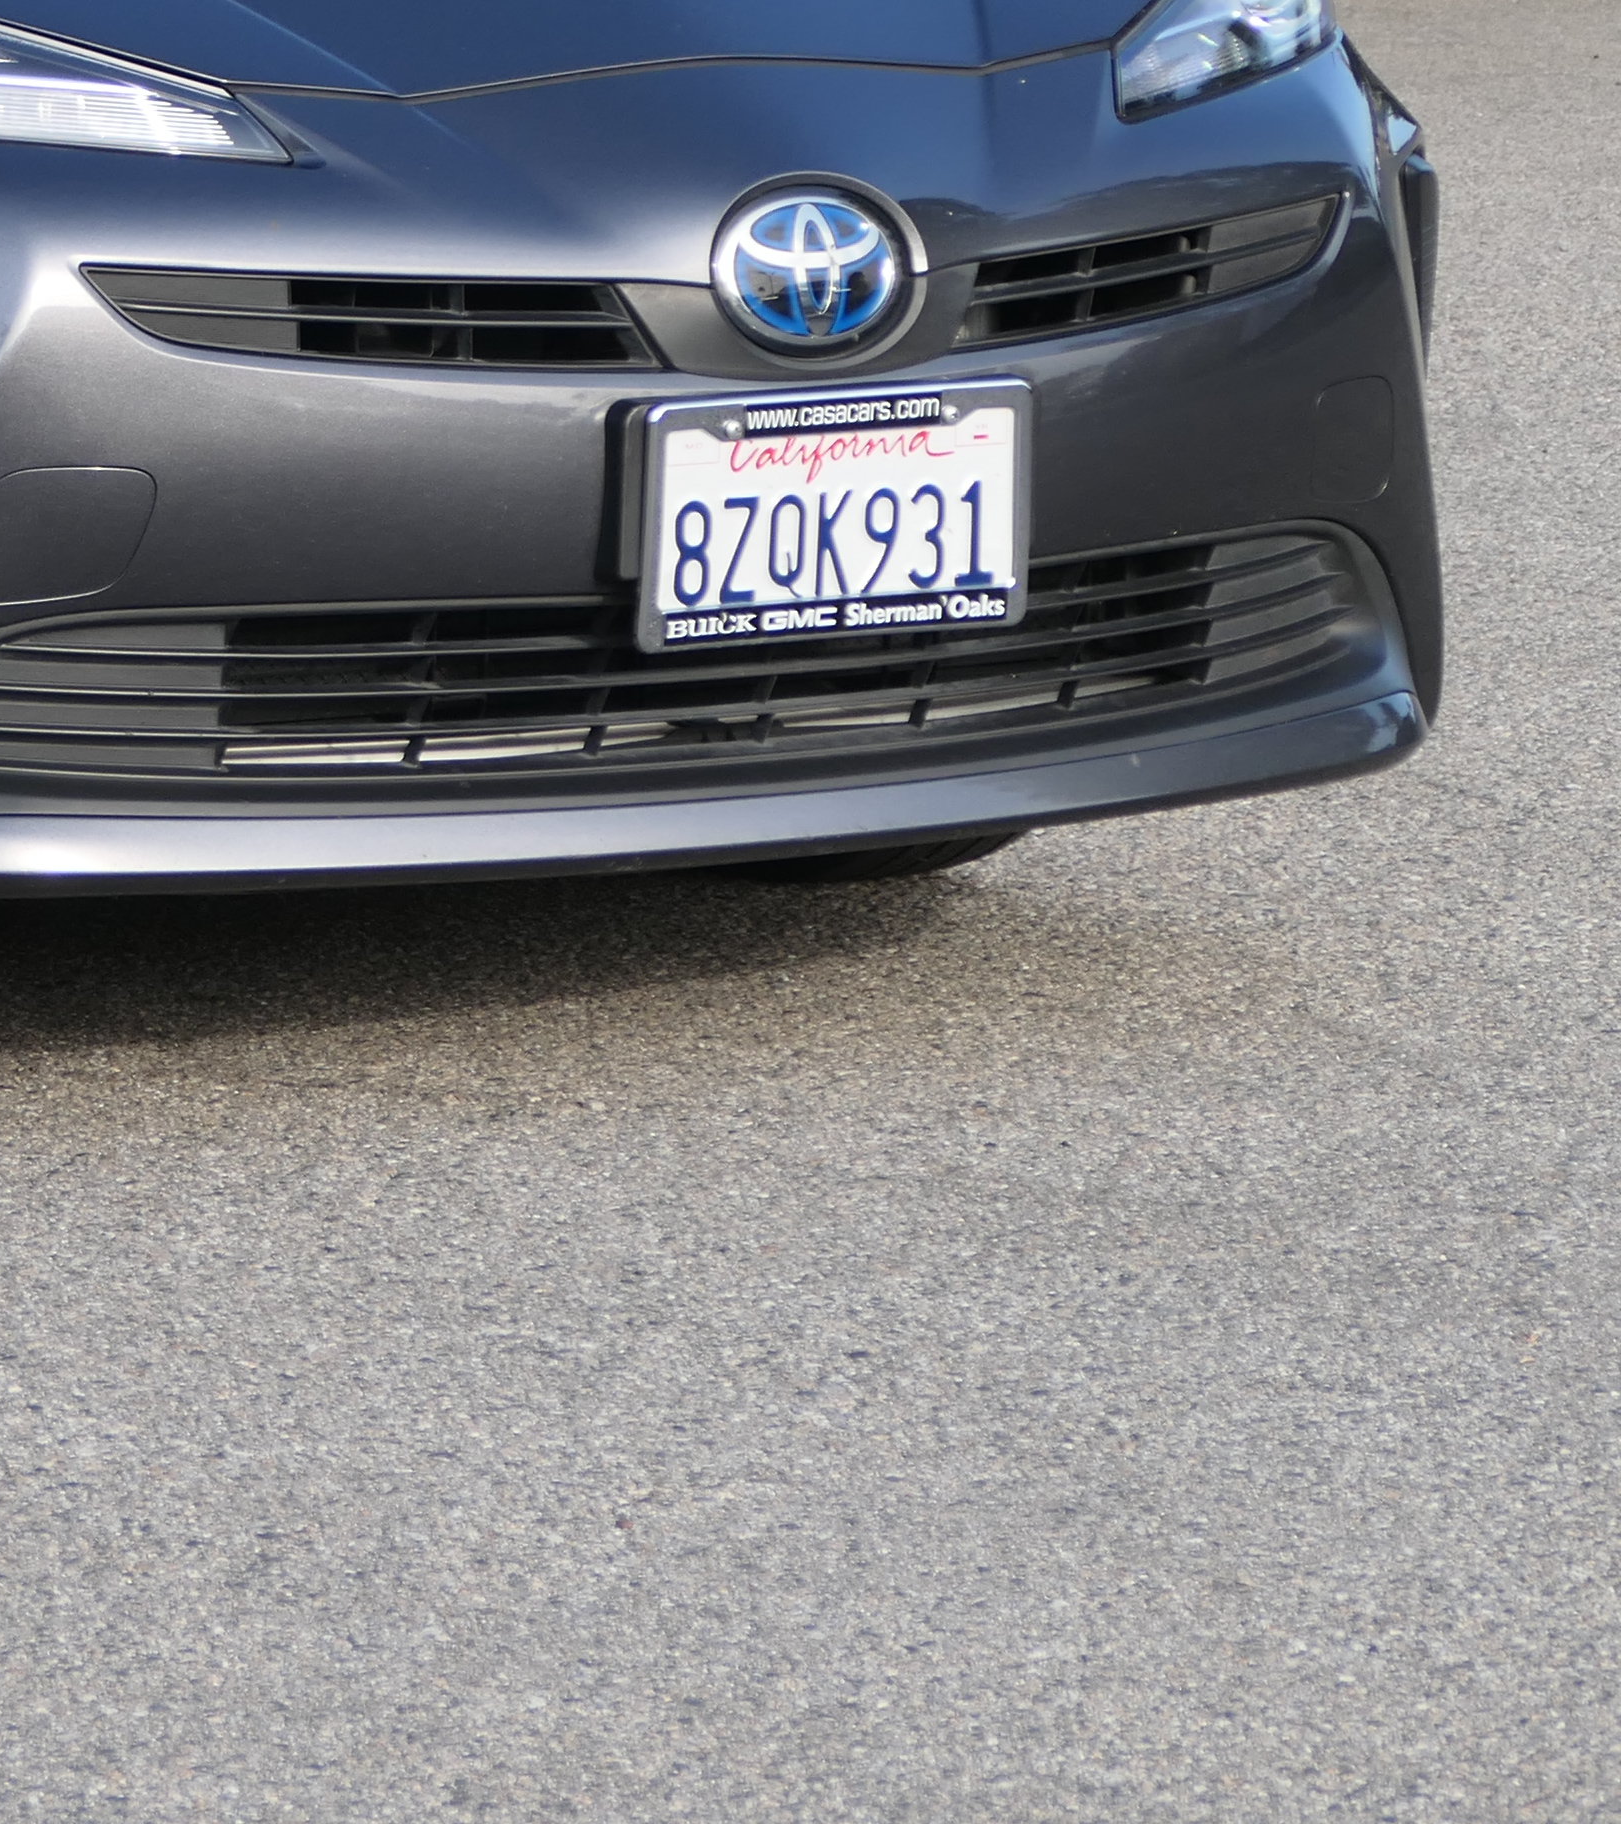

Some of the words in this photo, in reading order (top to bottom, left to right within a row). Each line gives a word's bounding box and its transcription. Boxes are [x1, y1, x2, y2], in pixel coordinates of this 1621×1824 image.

[746, 395, 941, 431] www.casacars.com
[730, 431, 955, 484] California
[673, 479, 994, 608] 8ZQK931
[666, 613, 758, 640] BUICK
[762, 606, 839, 632] GMC
[845, 599, 941, 627] Sherman
[944, 593, 1006, 619] Oaks
